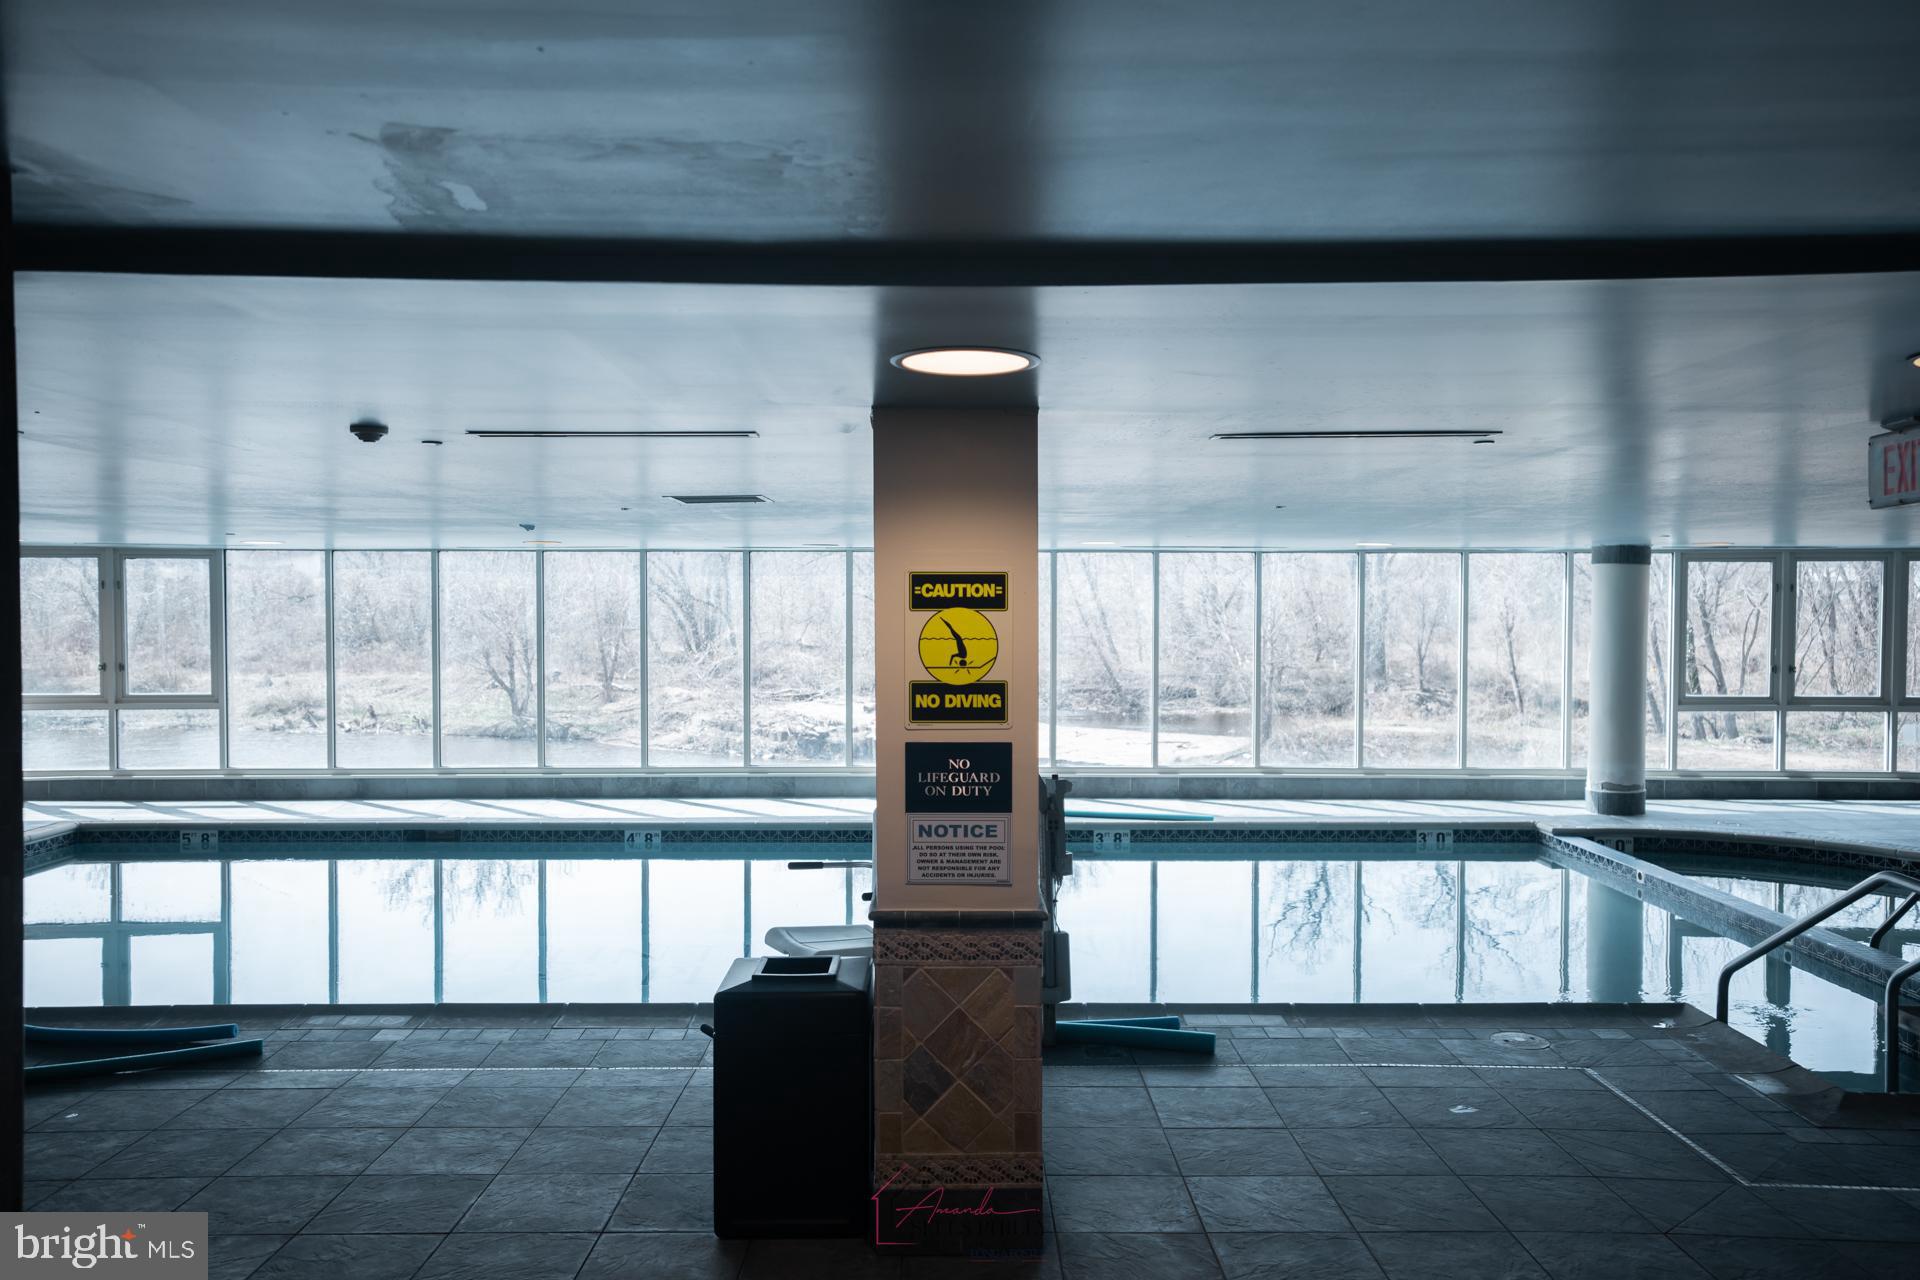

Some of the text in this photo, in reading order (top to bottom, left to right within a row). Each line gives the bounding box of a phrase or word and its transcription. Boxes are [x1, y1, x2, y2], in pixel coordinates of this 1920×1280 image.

[1883, 438, 1920, 496] EXI
[921, 583, 996, 598] CAUTION
[915, 694, 1002, 708] NO DIVING
[948, 758, 970, 769] NO
[918, 772, 1001, 783] LIFEGUARD
[924, 785, 992, 796] ON DUTY
[918, 824, 998, 838] NOTICE
